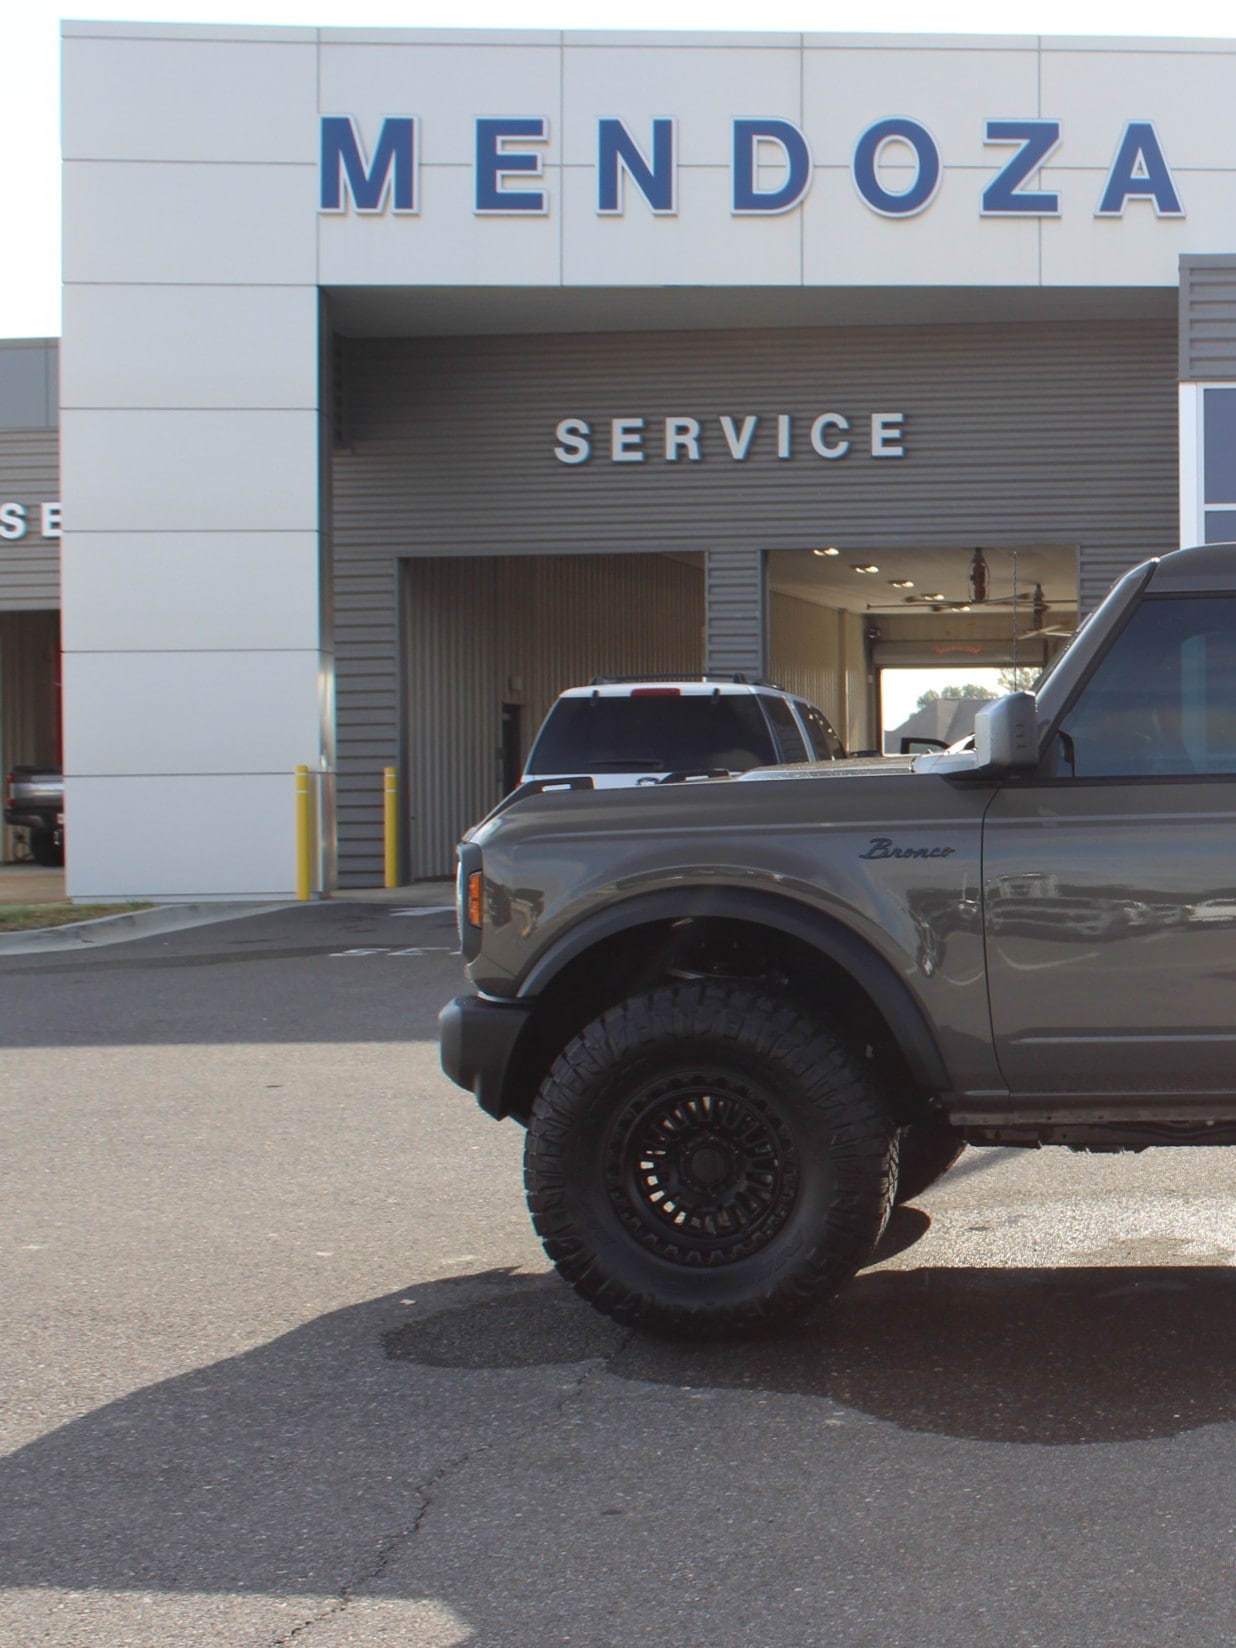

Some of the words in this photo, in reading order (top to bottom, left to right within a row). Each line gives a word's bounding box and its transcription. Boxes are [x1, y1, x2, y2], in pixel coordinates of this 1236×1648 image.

[318, 114, 1185, 219] MENDOZA
[554, 412, 905, 465] SERVICE
[0, 502, 64, 539] SE
[859, 837, 956, 860] Bronco
